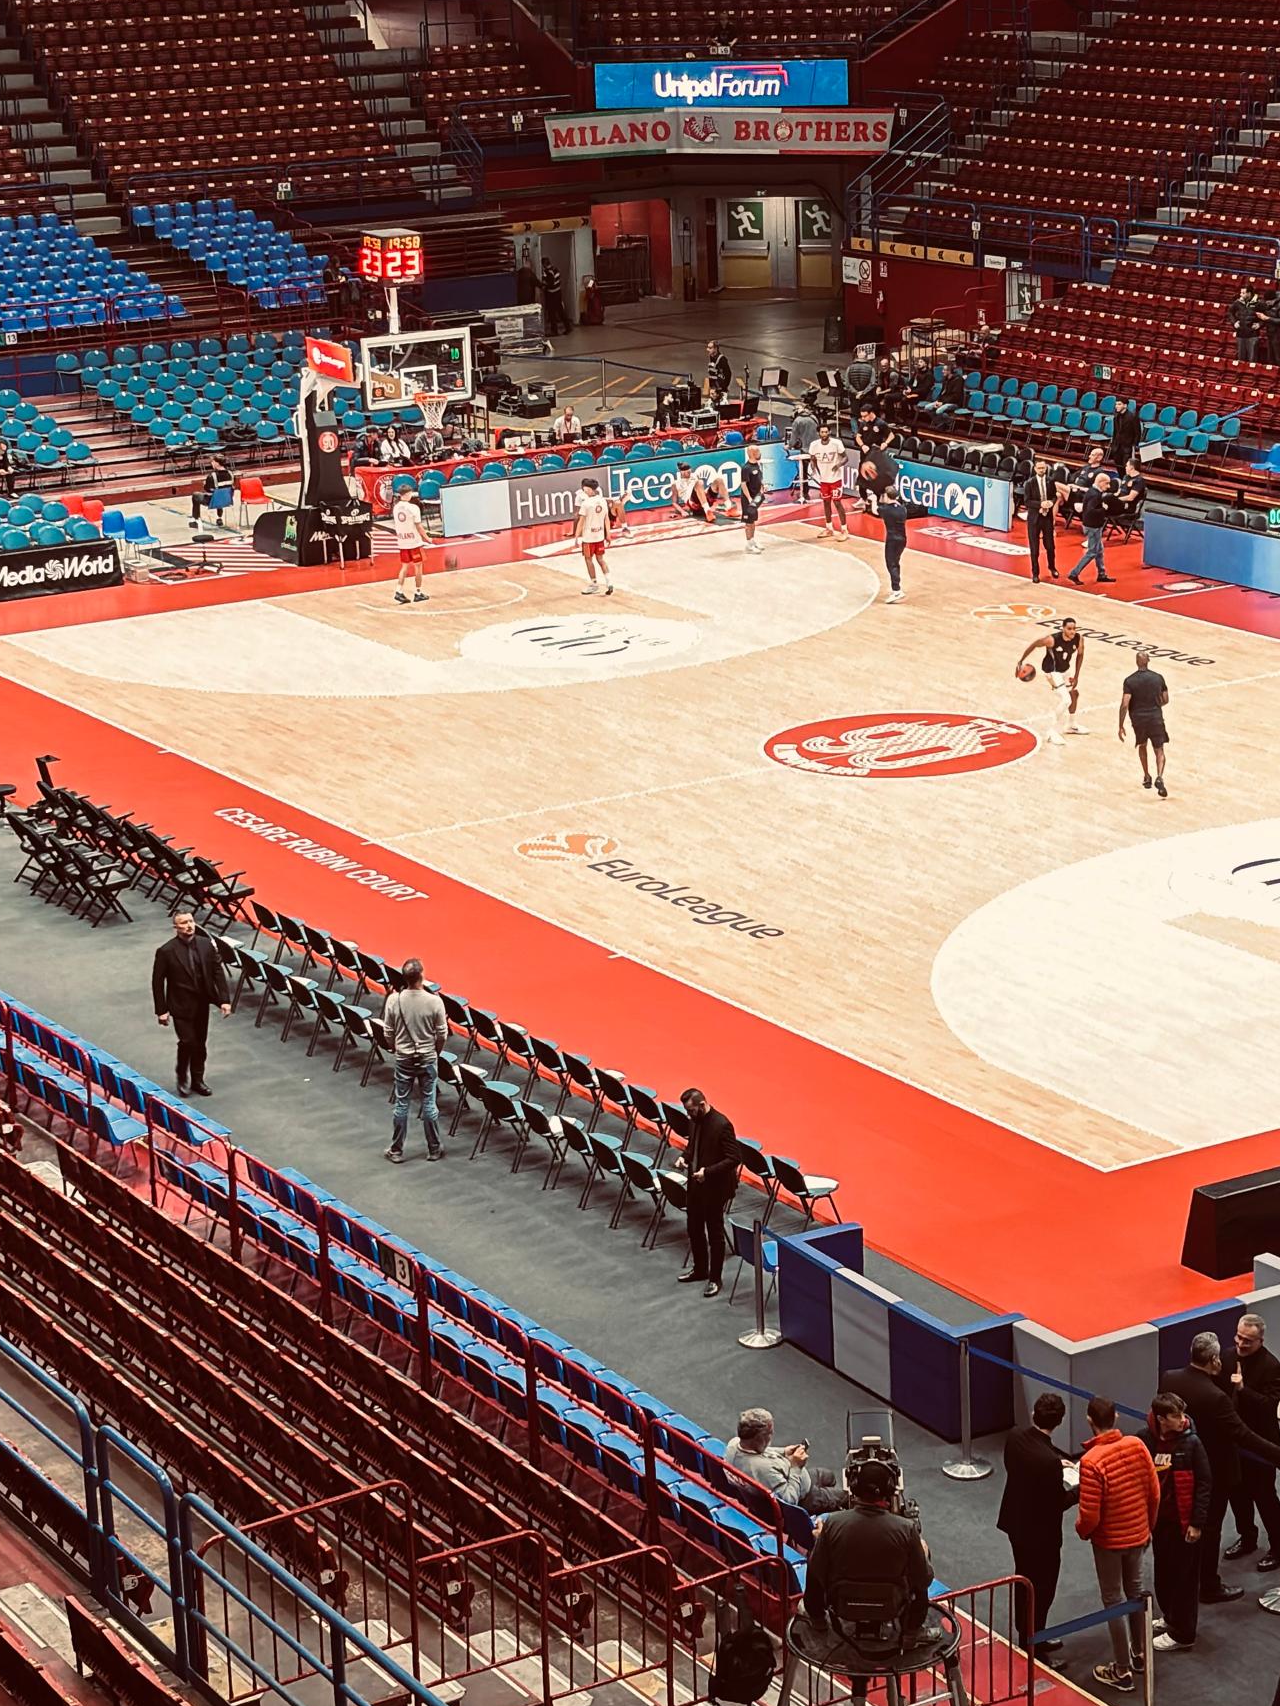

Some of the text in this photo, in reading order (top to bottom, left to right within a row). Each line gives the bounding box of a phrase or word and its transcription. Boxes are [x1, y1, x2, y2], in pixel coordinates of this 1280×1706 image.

[654, 69, 781, 104] UnipolForum
[551, 118, 889, 150] MILANO BROTHERS
[388, 236, 420, 249] 19:58
[361, 249, 420, 276] 23 23
[6, 334, 16, 345] 13
[515, 487, 574, 520] Hum
[63, 554, 114, 580] World
[214, 807, 300, 845] CESARE
[345, 867, 430, 902] COURT
[587, 859, 785, 939] EuroLeague
